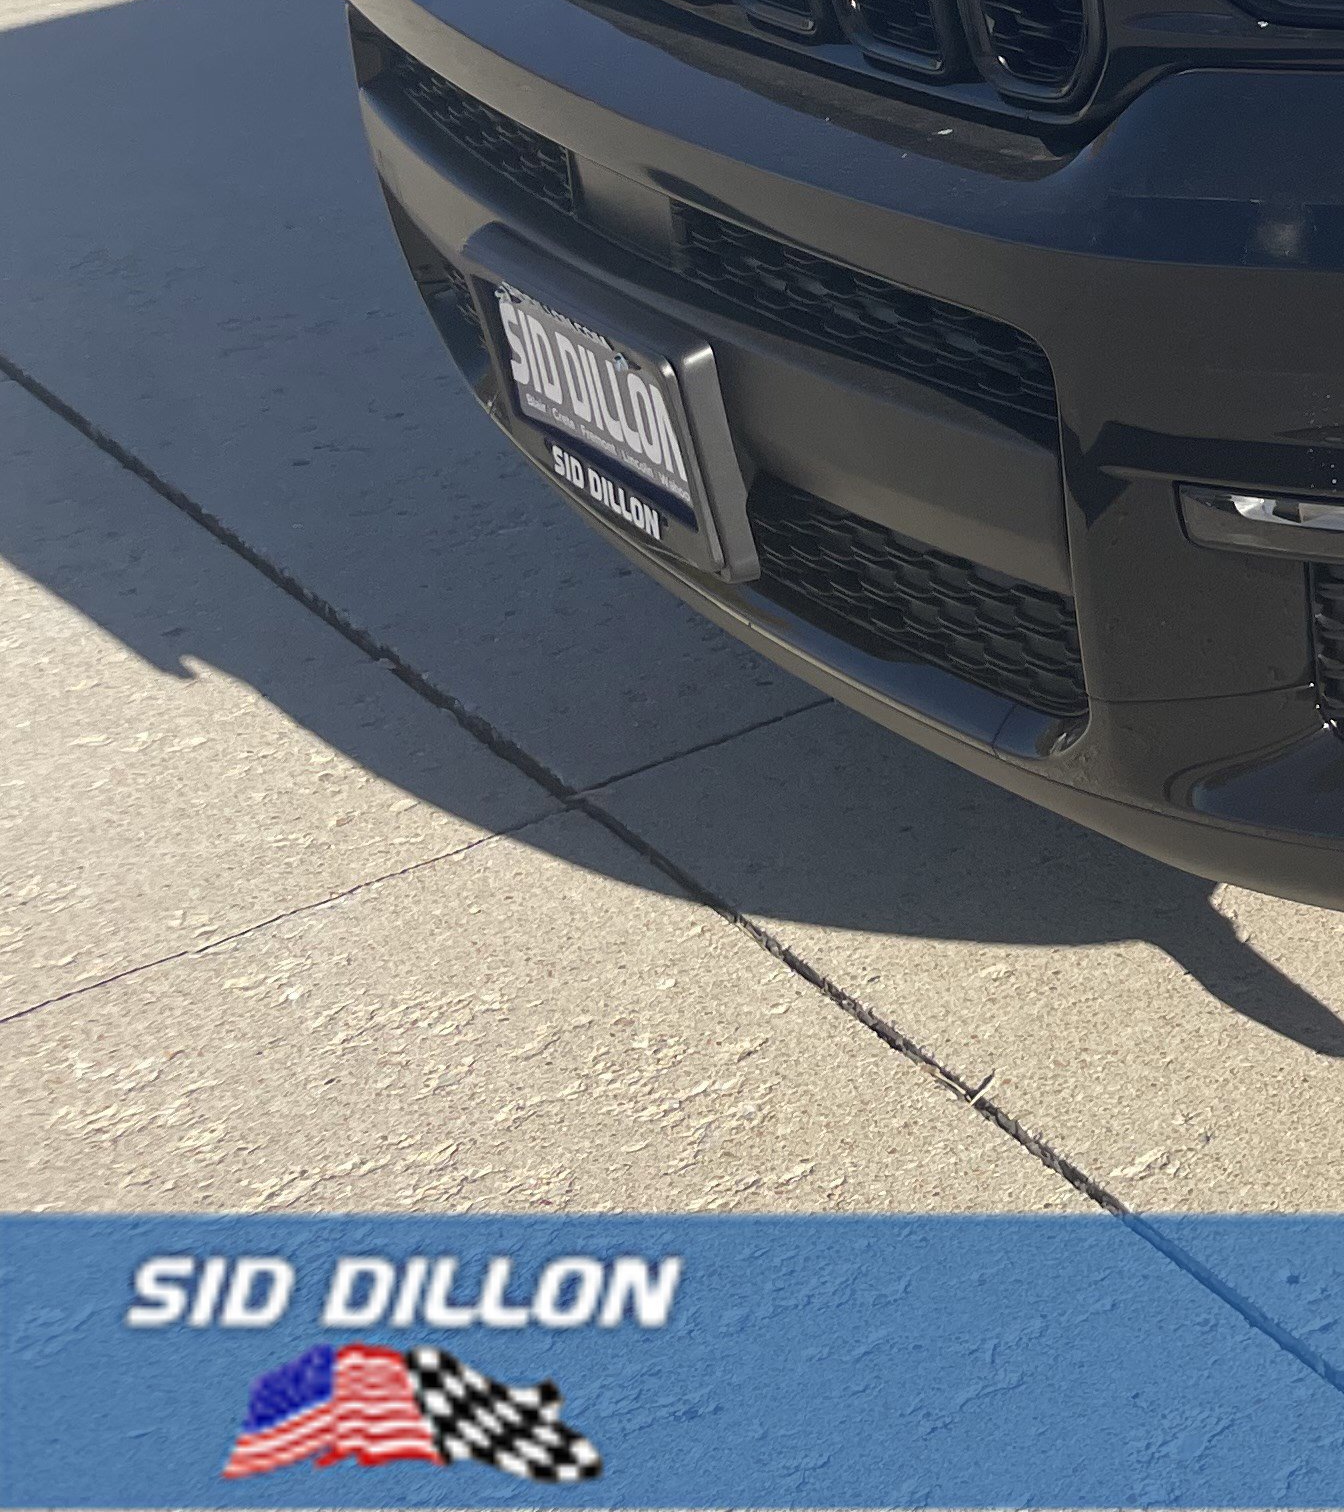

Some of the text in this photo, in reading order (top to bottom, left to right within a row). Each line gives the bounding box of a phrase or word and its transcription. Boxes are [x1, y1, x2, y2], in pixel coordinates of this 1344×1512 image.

[499, 302, 563, 405] SID
[554, 331, 689, 483] DILLON
[551, 444, 662, 541] SID DILLON
